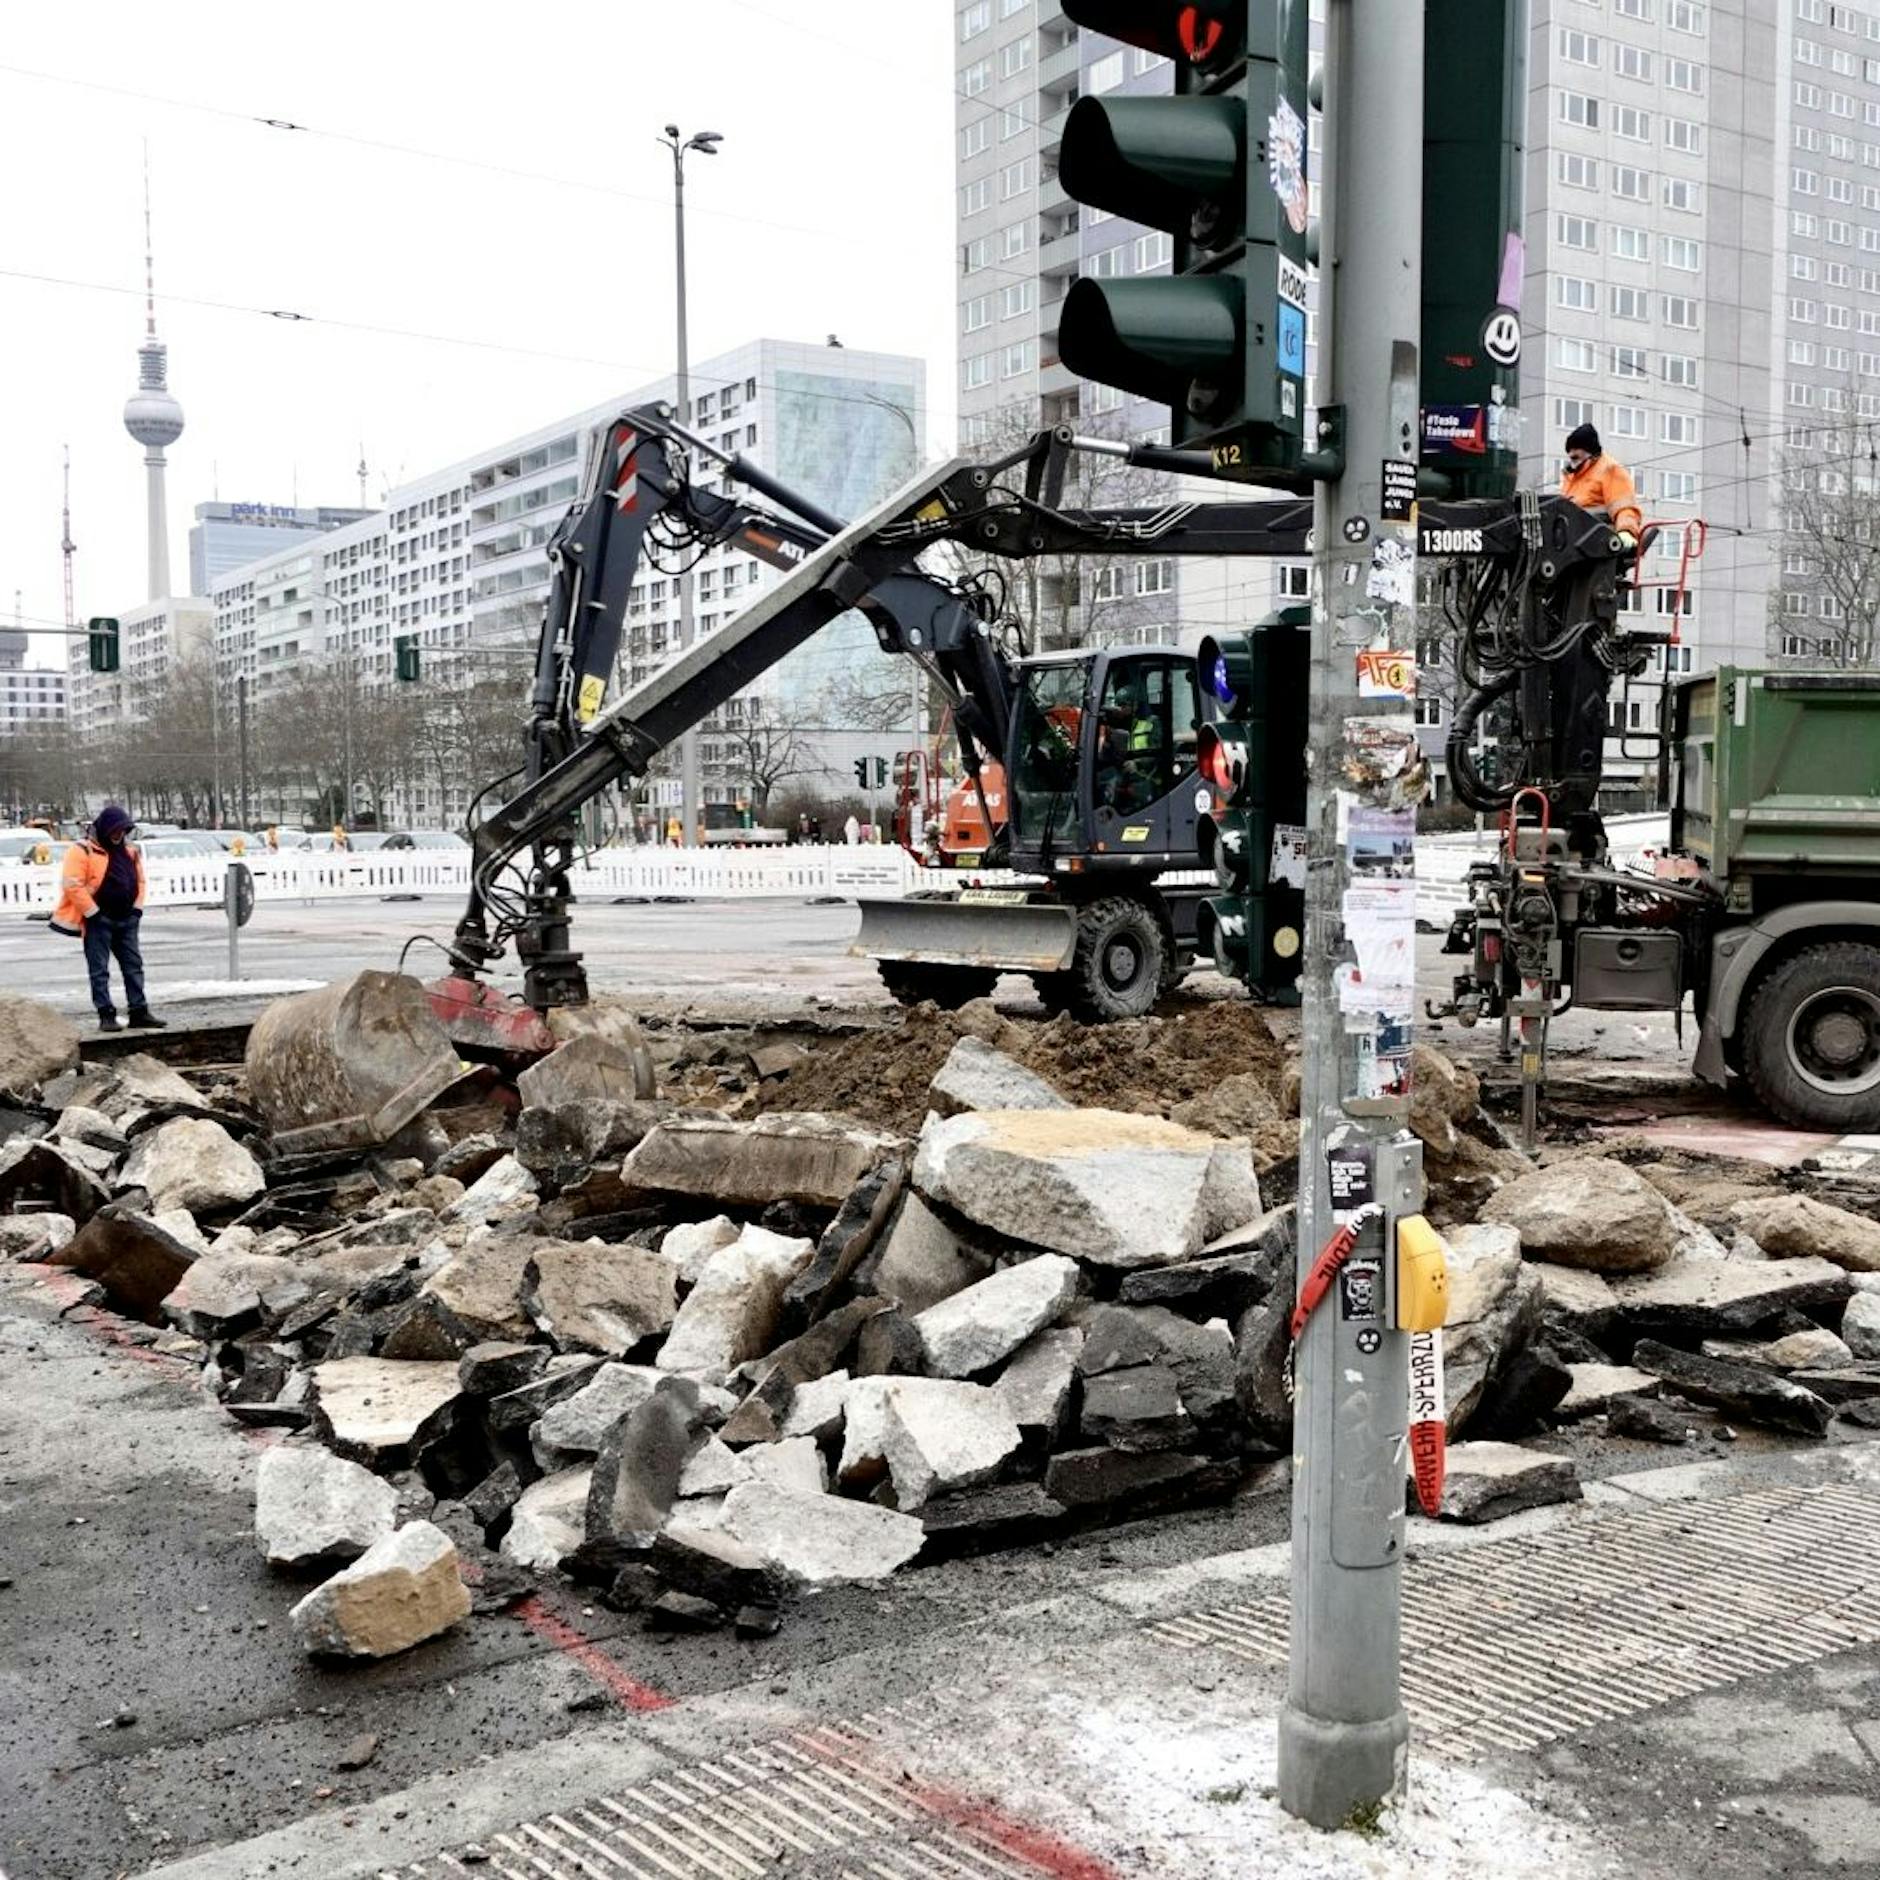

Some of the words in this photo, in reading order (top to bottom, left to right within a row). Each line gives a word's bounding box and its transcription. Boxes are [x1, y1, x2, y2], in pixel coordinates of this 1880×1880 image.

[1426, 426, 1476, 438] Takedown
[231, 501, 267, 518] park
[270, 503, 296, 517] inn
[1423, 530, 1483, 552] 1300RS
